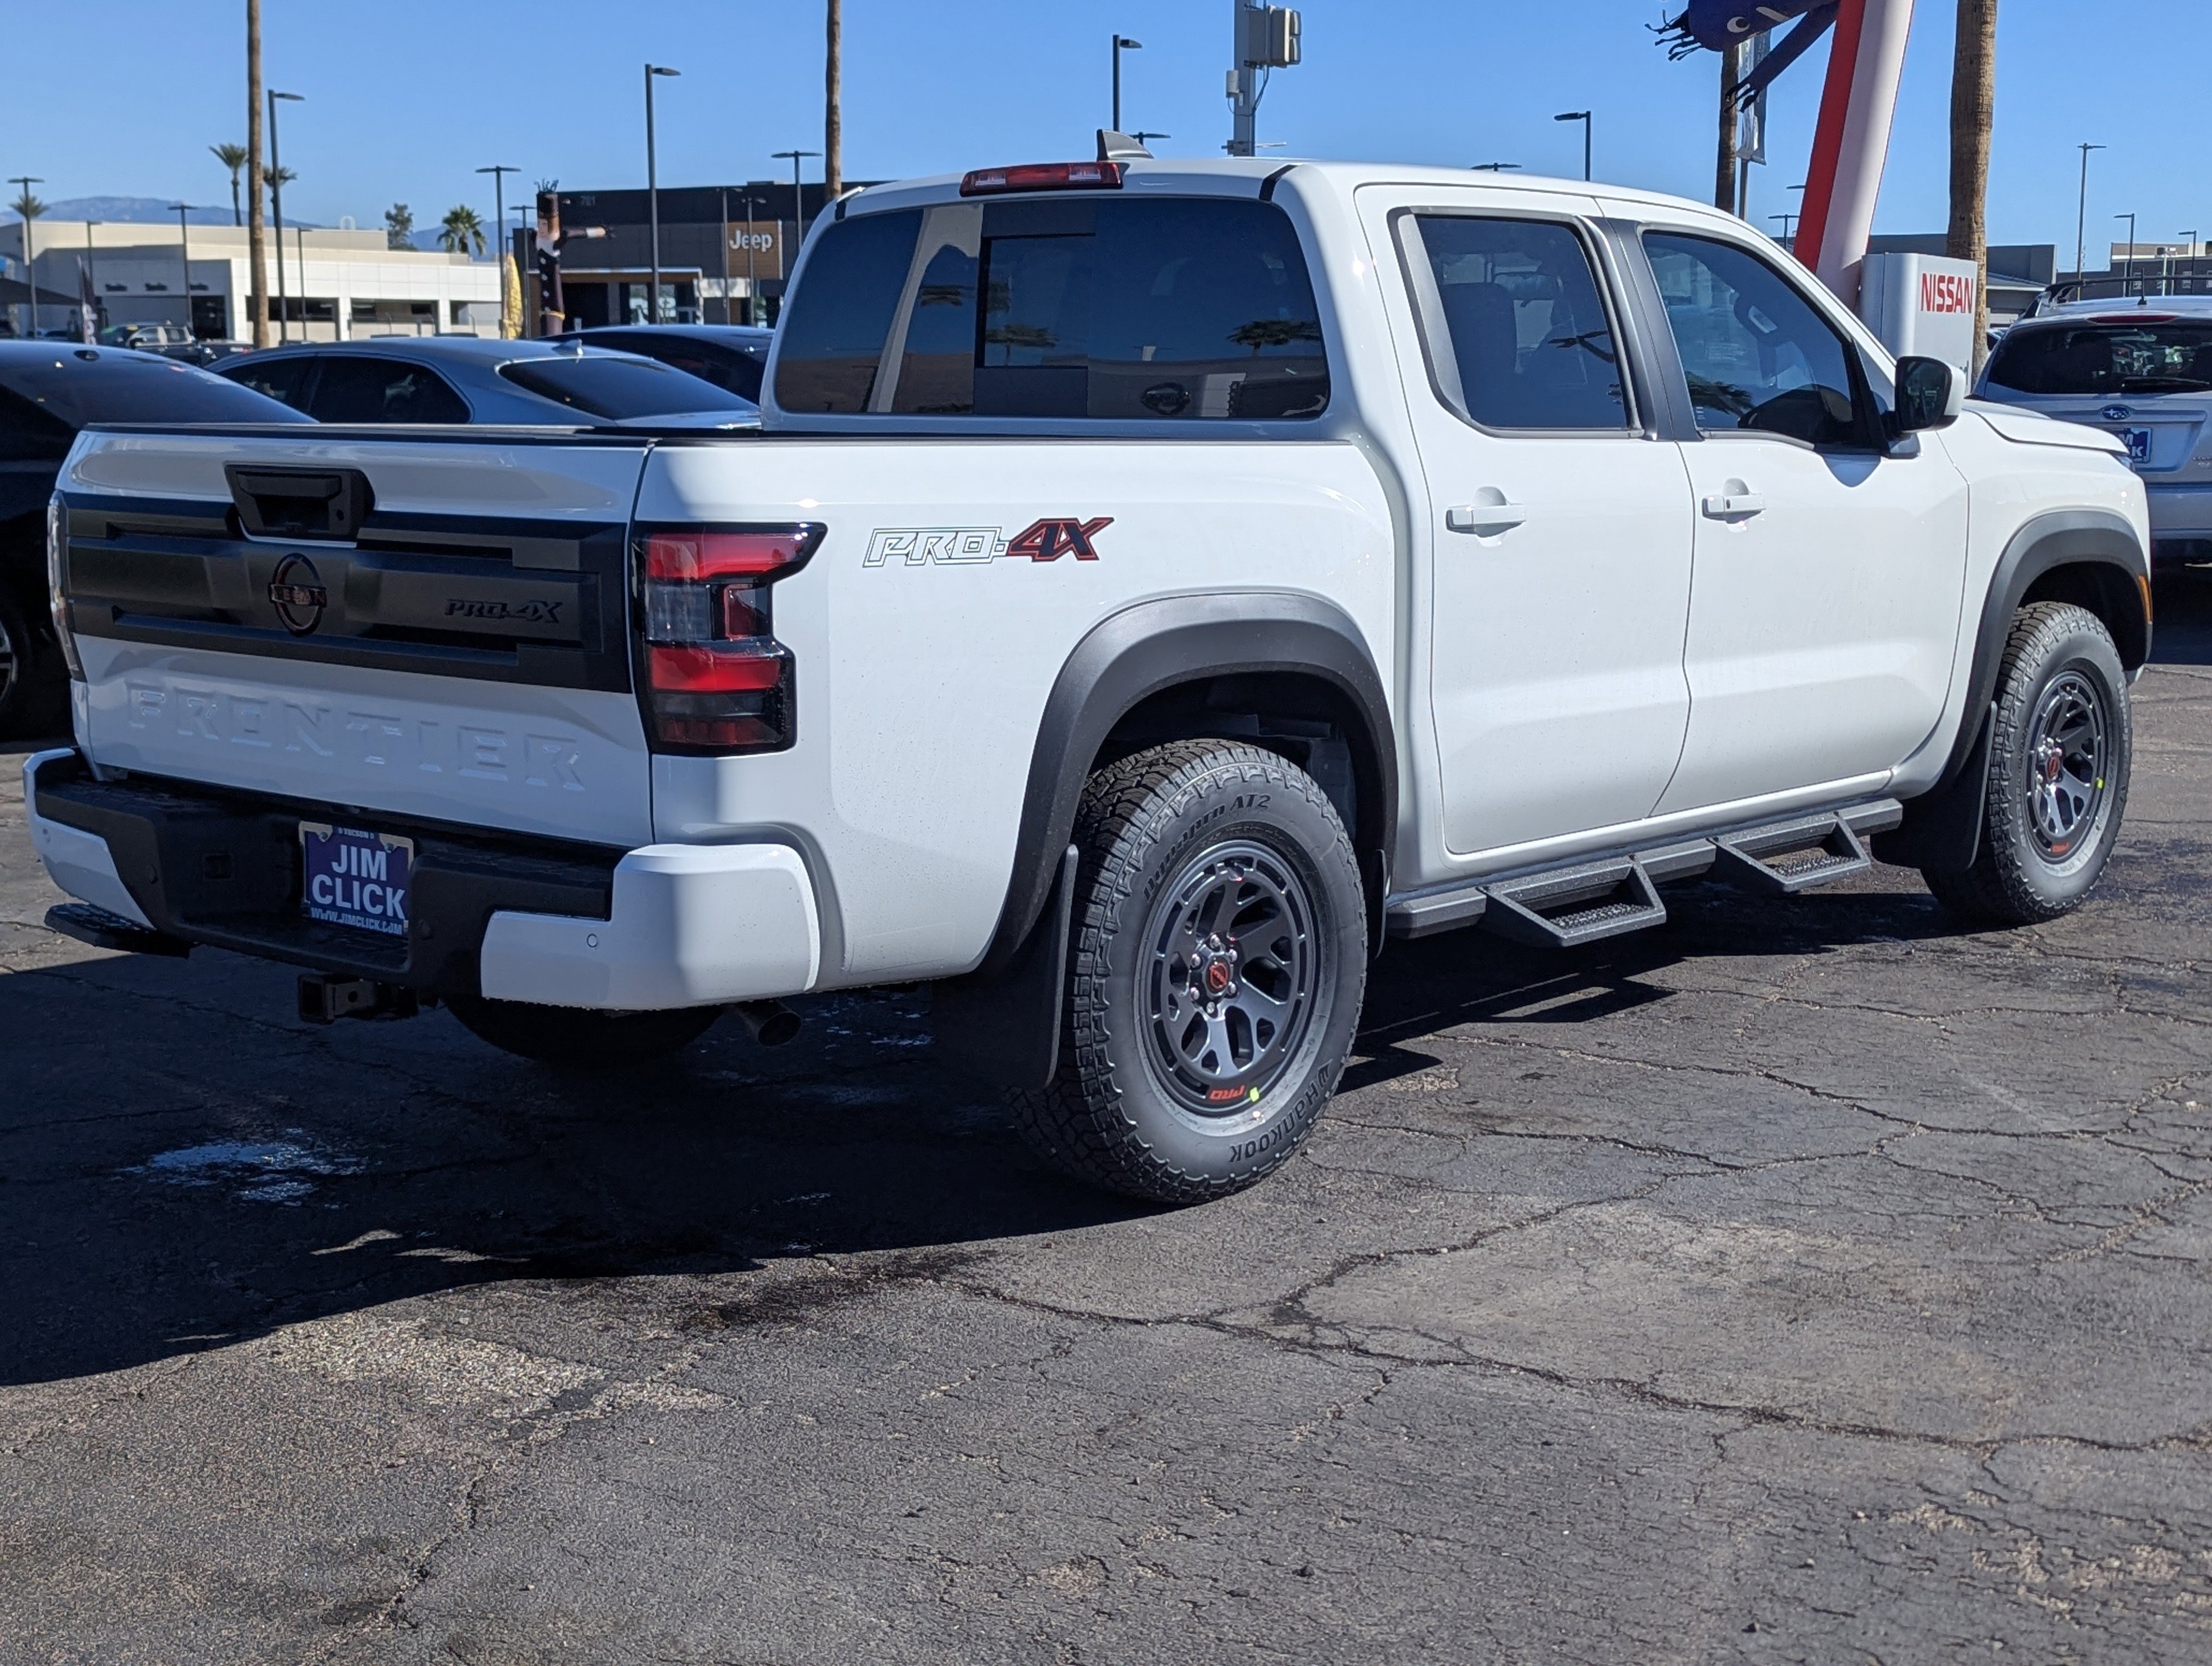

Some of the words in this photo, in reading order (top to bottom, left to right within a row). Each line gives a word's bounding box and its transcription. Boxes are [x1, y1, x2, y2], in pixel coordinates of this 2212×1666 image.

[729, 229, 773, 252] Jeep
[1920, 273, 1973, 313] NISSAN
[127, 681, 585, 792] FRONTIER
[1229, 793, 1272, 812] AT2
[331, 844, 387, 881] JIM
[312, 874, 406, 920] CLICK
[1209, 1084, 1245, 1100] PRO
